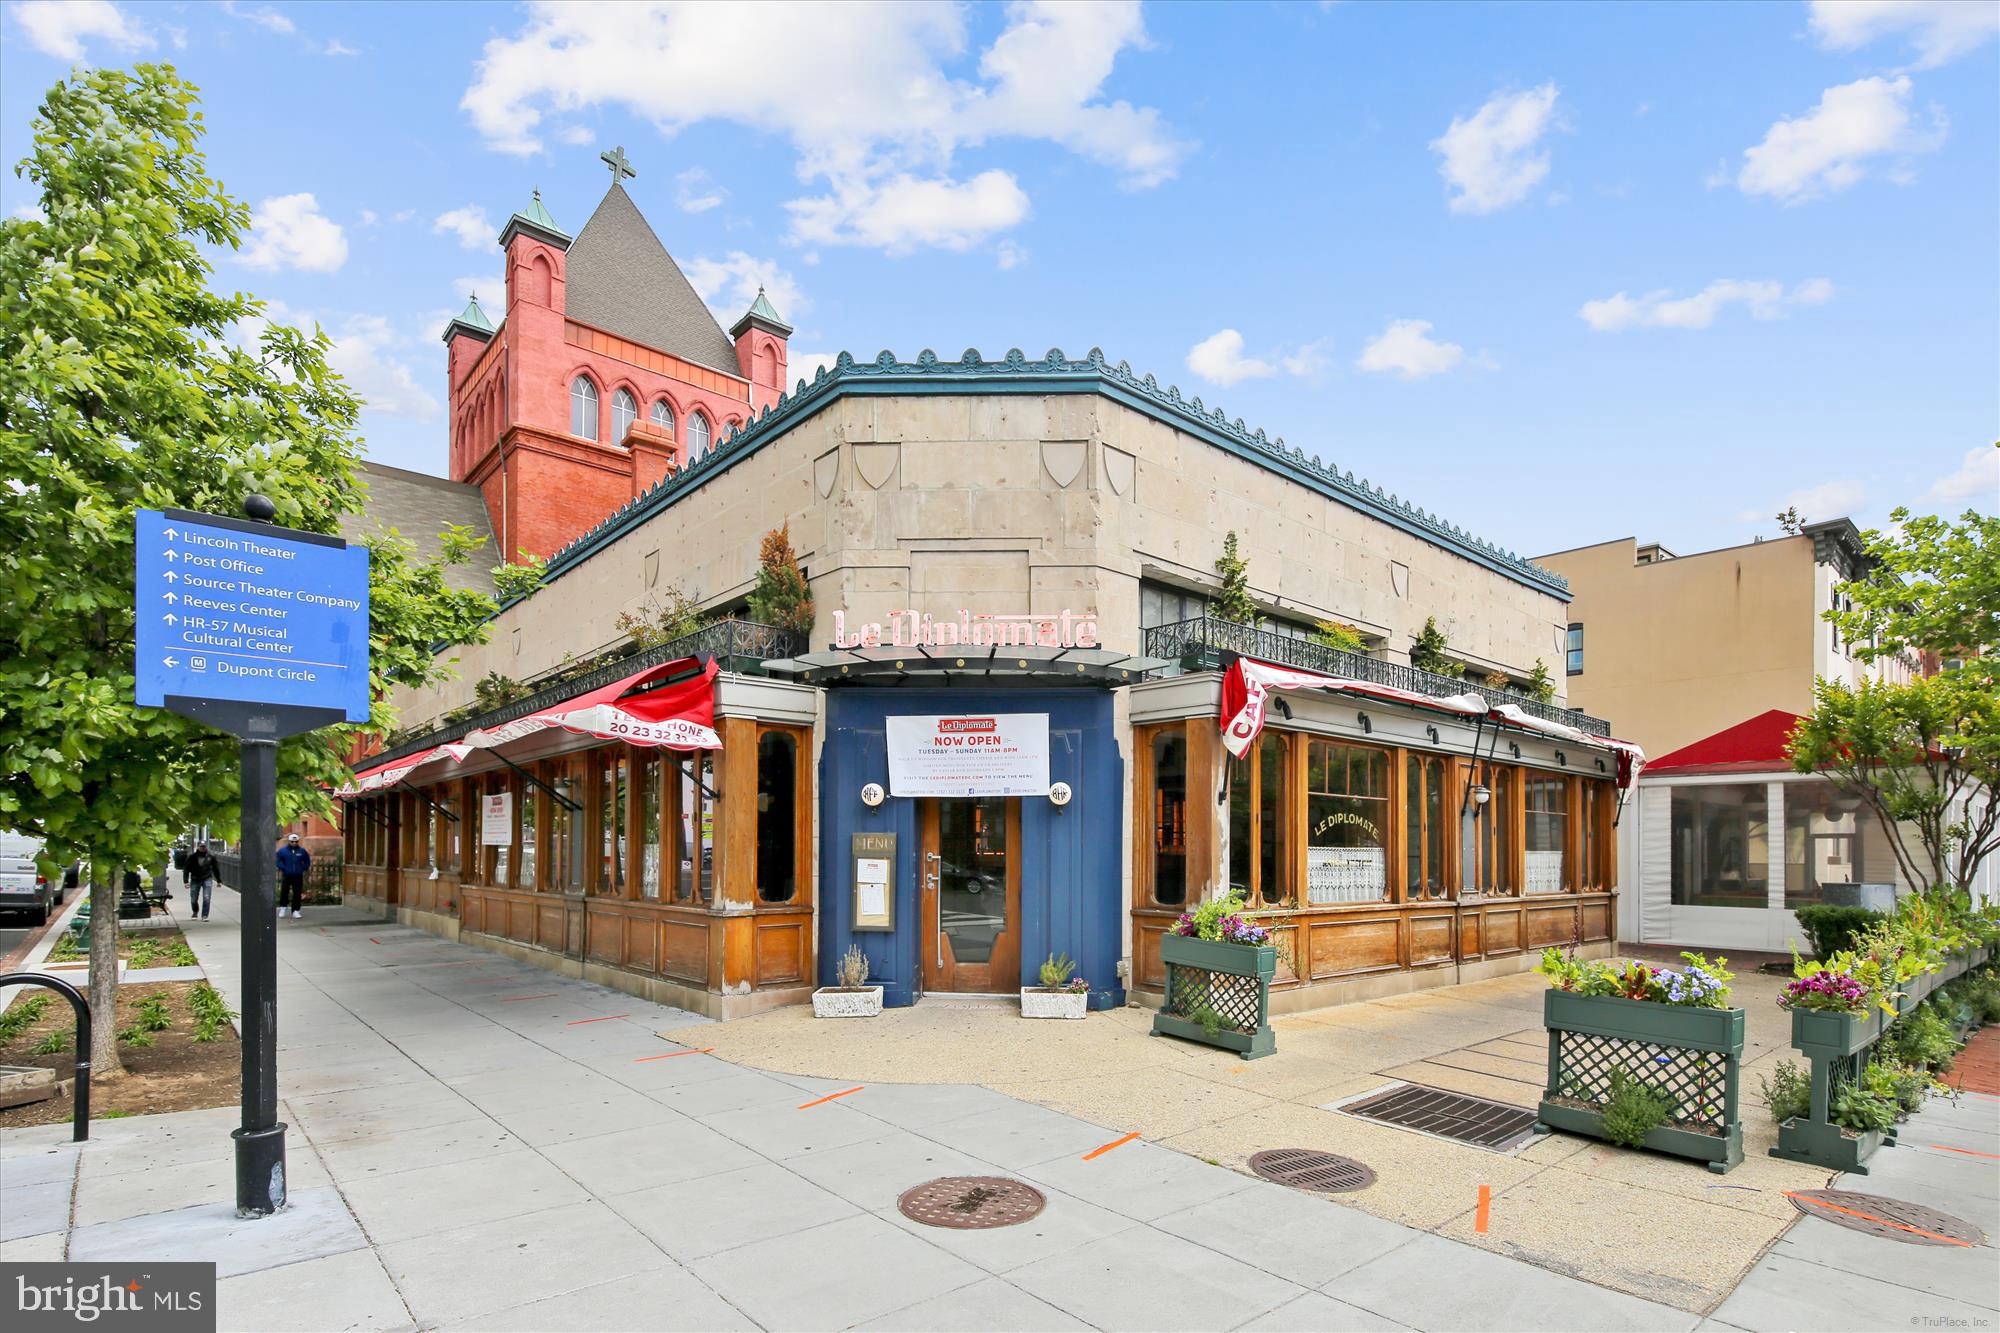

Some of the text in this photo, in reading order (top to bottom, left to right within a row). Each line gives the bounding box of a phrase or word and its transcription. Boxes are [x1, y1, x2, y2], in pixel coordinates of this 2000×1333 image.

[184, 531, 296, 560] Lincoln Theater
[184, 552, 264, 575] Post Office
[184, 574, 361, 612] Source Theater Company
[184, 594, 288, 619] Reeves Center
[183, 616, 287, 639] HR-57 Musical
[832, 608, 1097, 648] Le Diplomate
[183, 631, 293, 654] Cultural Center
[217, 661, 273, 679] Dupont
[277, 667, 316, 682] Circle
[1233, 677, 1260, 738] CAF
[610, 722, 629, 734] 20
[632, 726, 650, 737] 23
[654, 729, 671, 740] 32
[941, 720, 993, 731] Le Diplomate
[934, 735, 1001, 746] NOW OPEN
[1314, 812, 1379, 839] LE DIPLOMATE
